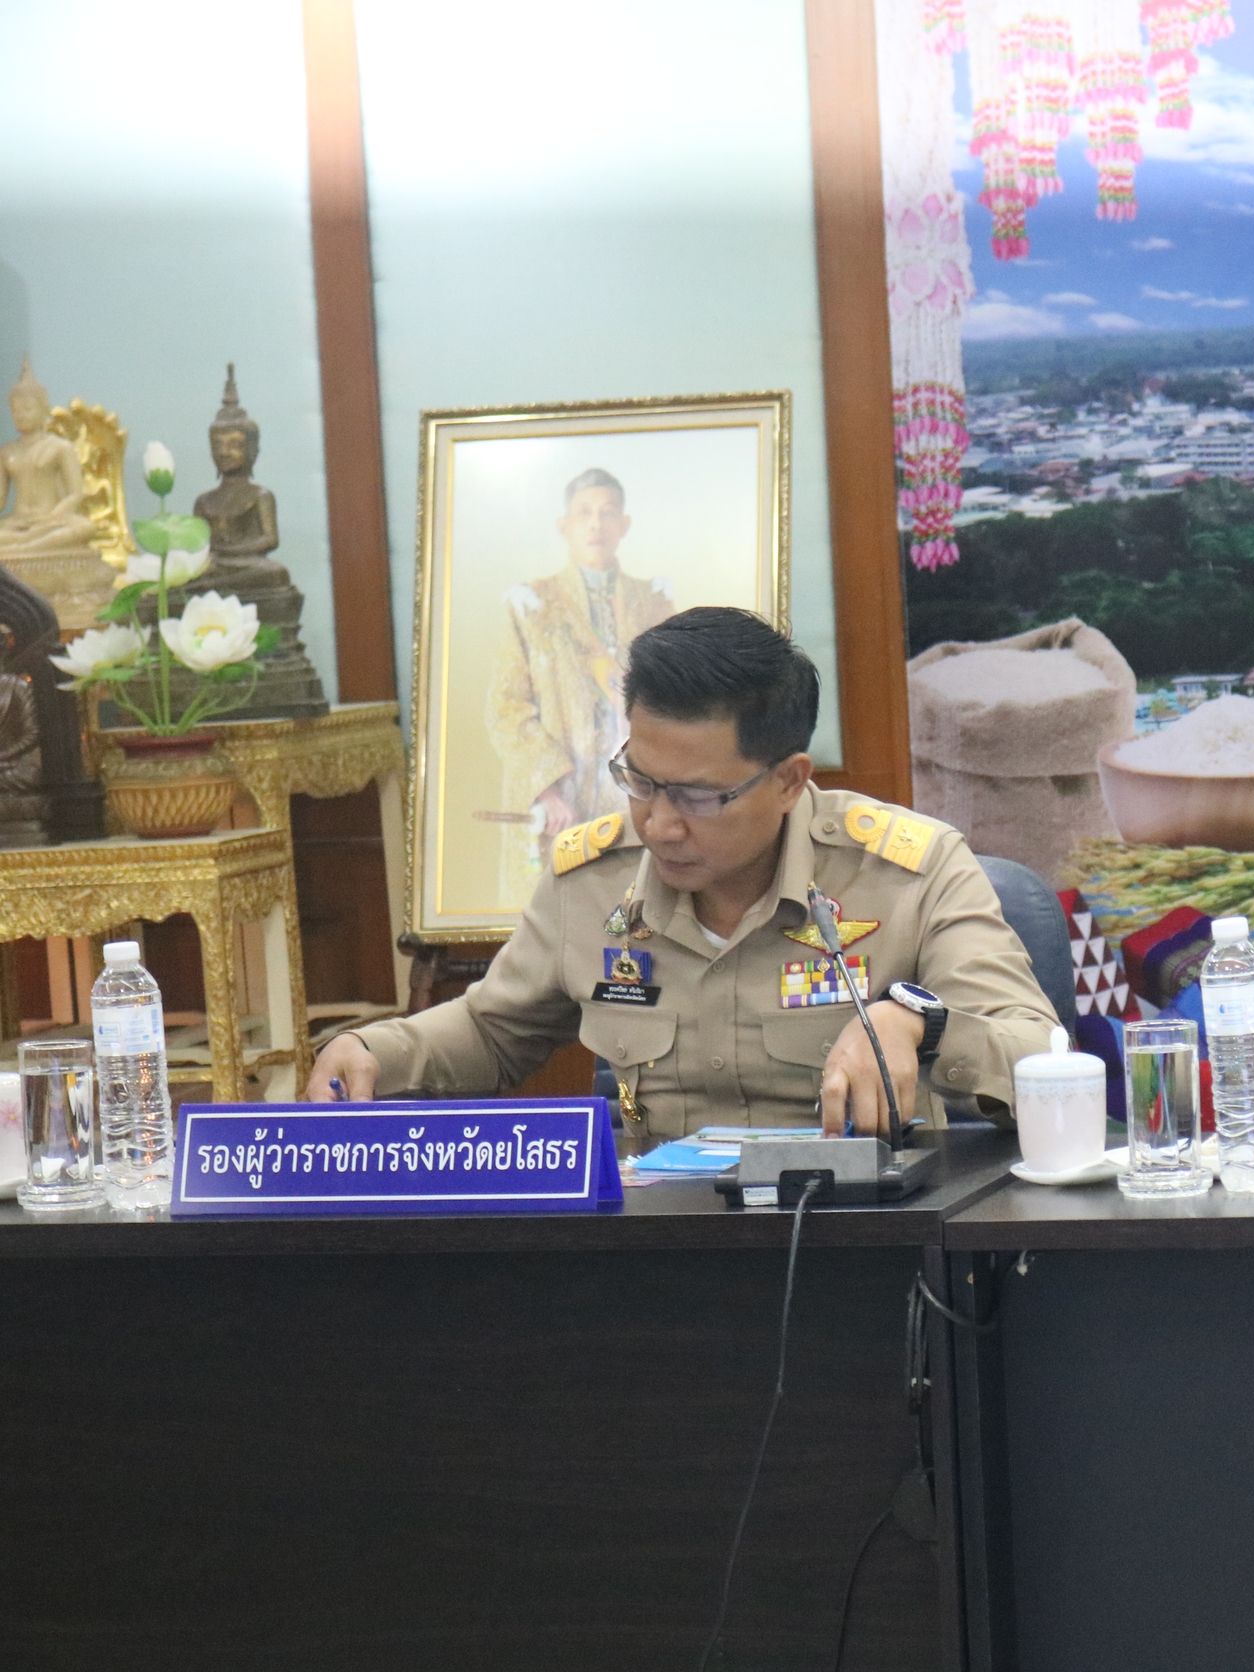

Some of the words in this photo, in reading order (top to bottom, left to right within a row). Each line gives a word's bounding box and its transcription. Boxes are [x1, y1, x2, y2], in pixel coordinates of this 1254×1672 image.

[197, 1124, 579, 1189] รองผู้ว่าราชการจังหวัดยโสธร
